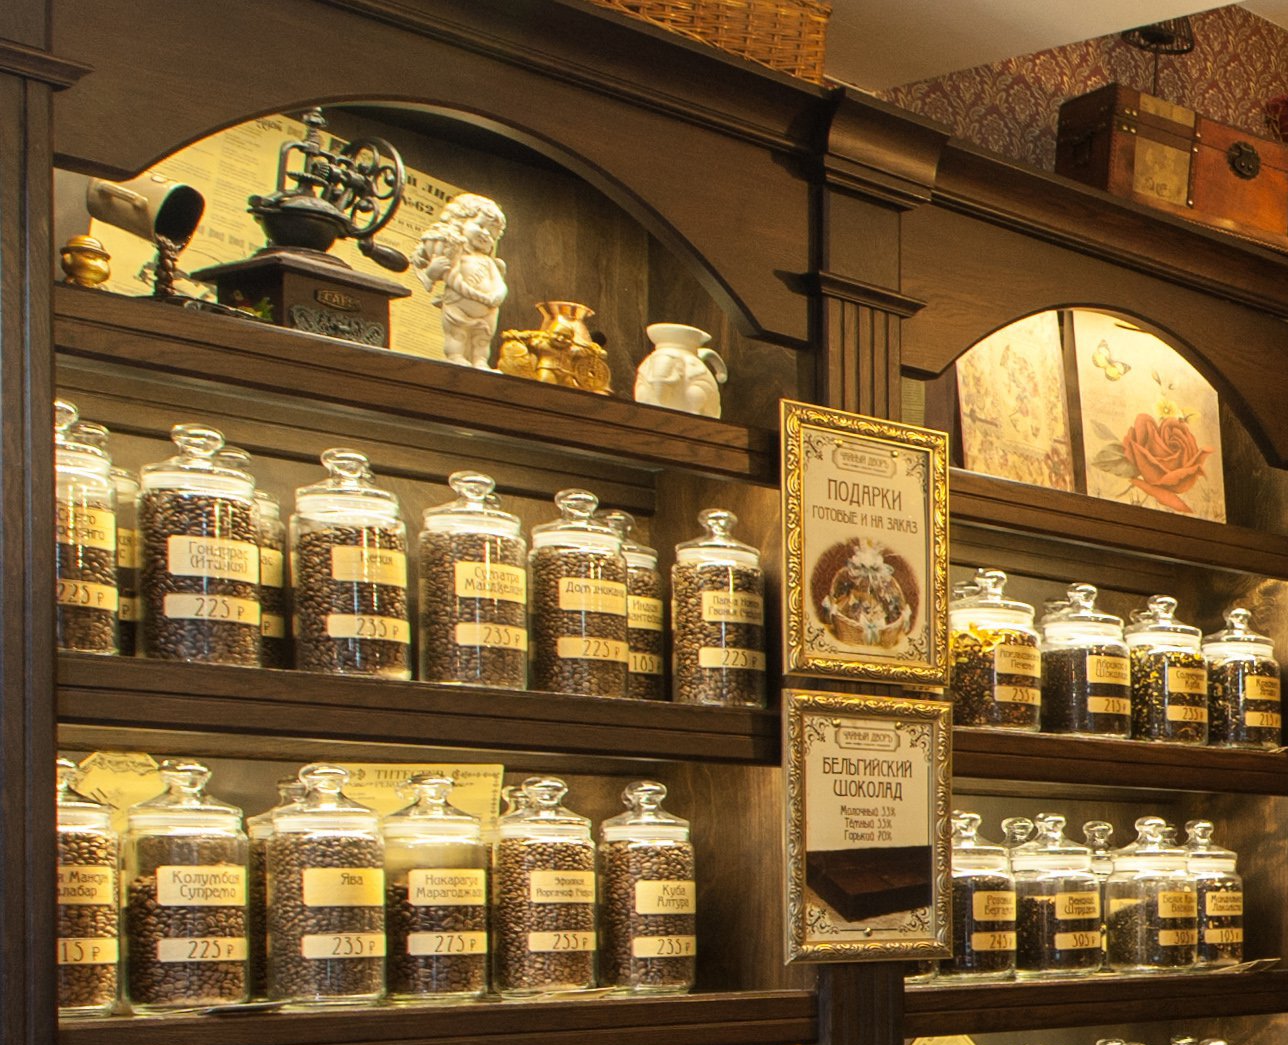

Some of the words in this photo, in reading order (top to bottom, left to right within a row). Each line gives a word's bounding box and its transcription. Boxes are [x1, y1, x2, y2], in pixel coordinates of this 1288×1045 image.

[827, 478, 903, 512] ПОДАРКИ
[812, 503, 858, 526] ГОТОВЫЕ
[860, 514, 868, 525] И
[870, 514, 884, 530] НА
[886, 516, 919, 535] ЗАКАЗ
[194, 597, 231, 618] 225
[356, 617, 388, 638] 235
[483, 625, 511, 646] 235
[582, 638, 611, 658] 225
[722, 649, 749, 667] 225
[822, 756, 913, 778] БЕЛЬГИЙСКИЙ
[832, 779, 903, 801] ШОКОЛАД
[840, 805, 880, 818] Молочный
[844, 829, 876, 842] Горький
[877, 830, 893, 842] 70%
[172, 870, 240, 886] Колумбия
[340, 872, 364, 887] Ява
[179, 884, 236, 900] Супремо
[661, 884, 687, 897] Куба
[187, 940, 221, 960] 225
[331, 937, 364, 956] 235
[434, 935, 466, 954] 275
